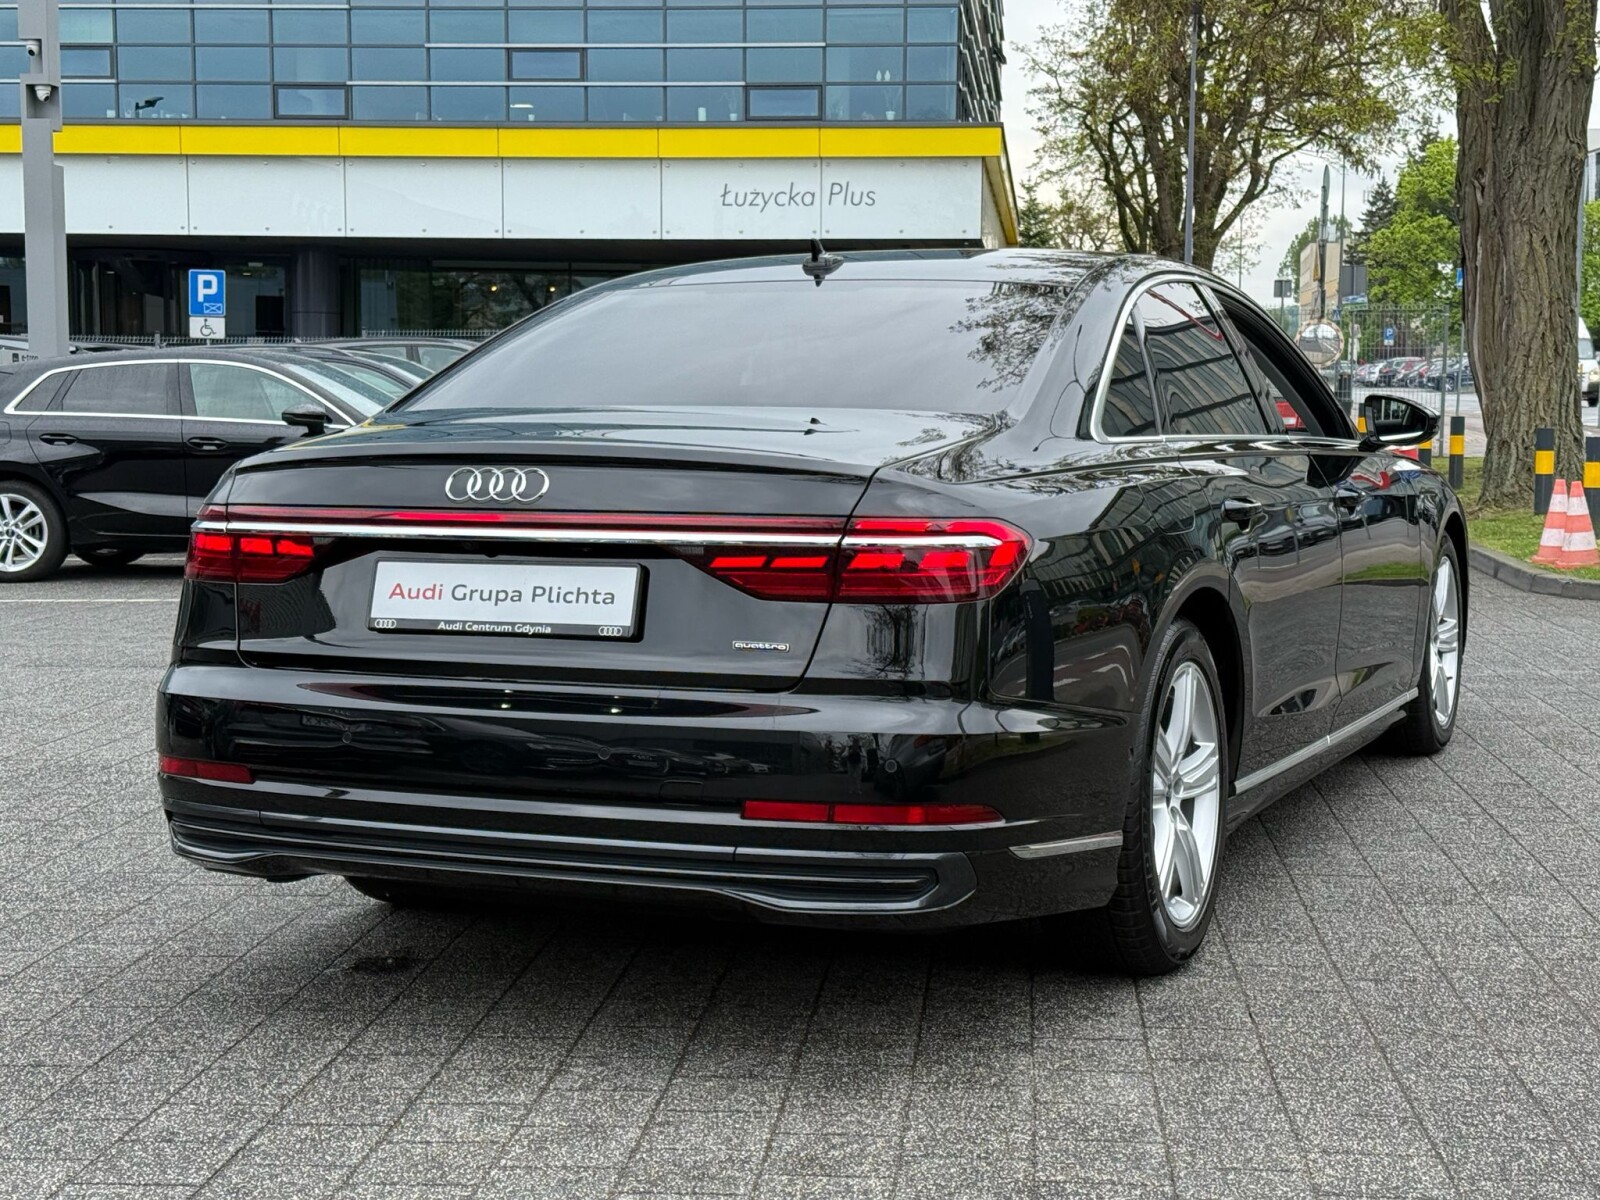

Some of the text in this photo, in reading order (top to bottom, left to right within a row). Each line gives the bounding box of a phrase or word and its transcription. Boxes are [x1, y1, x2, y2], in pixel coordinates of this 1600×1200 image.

[720, 181, 877, 213] Łużycka Plus
[197, 274, 218, 303] P
[388, 582, 616, 606] Audi Grupa Plichta
[437, 621, 552, 635] Audi Centrum Gdynia
[734, 642, 787, 650] quattro
